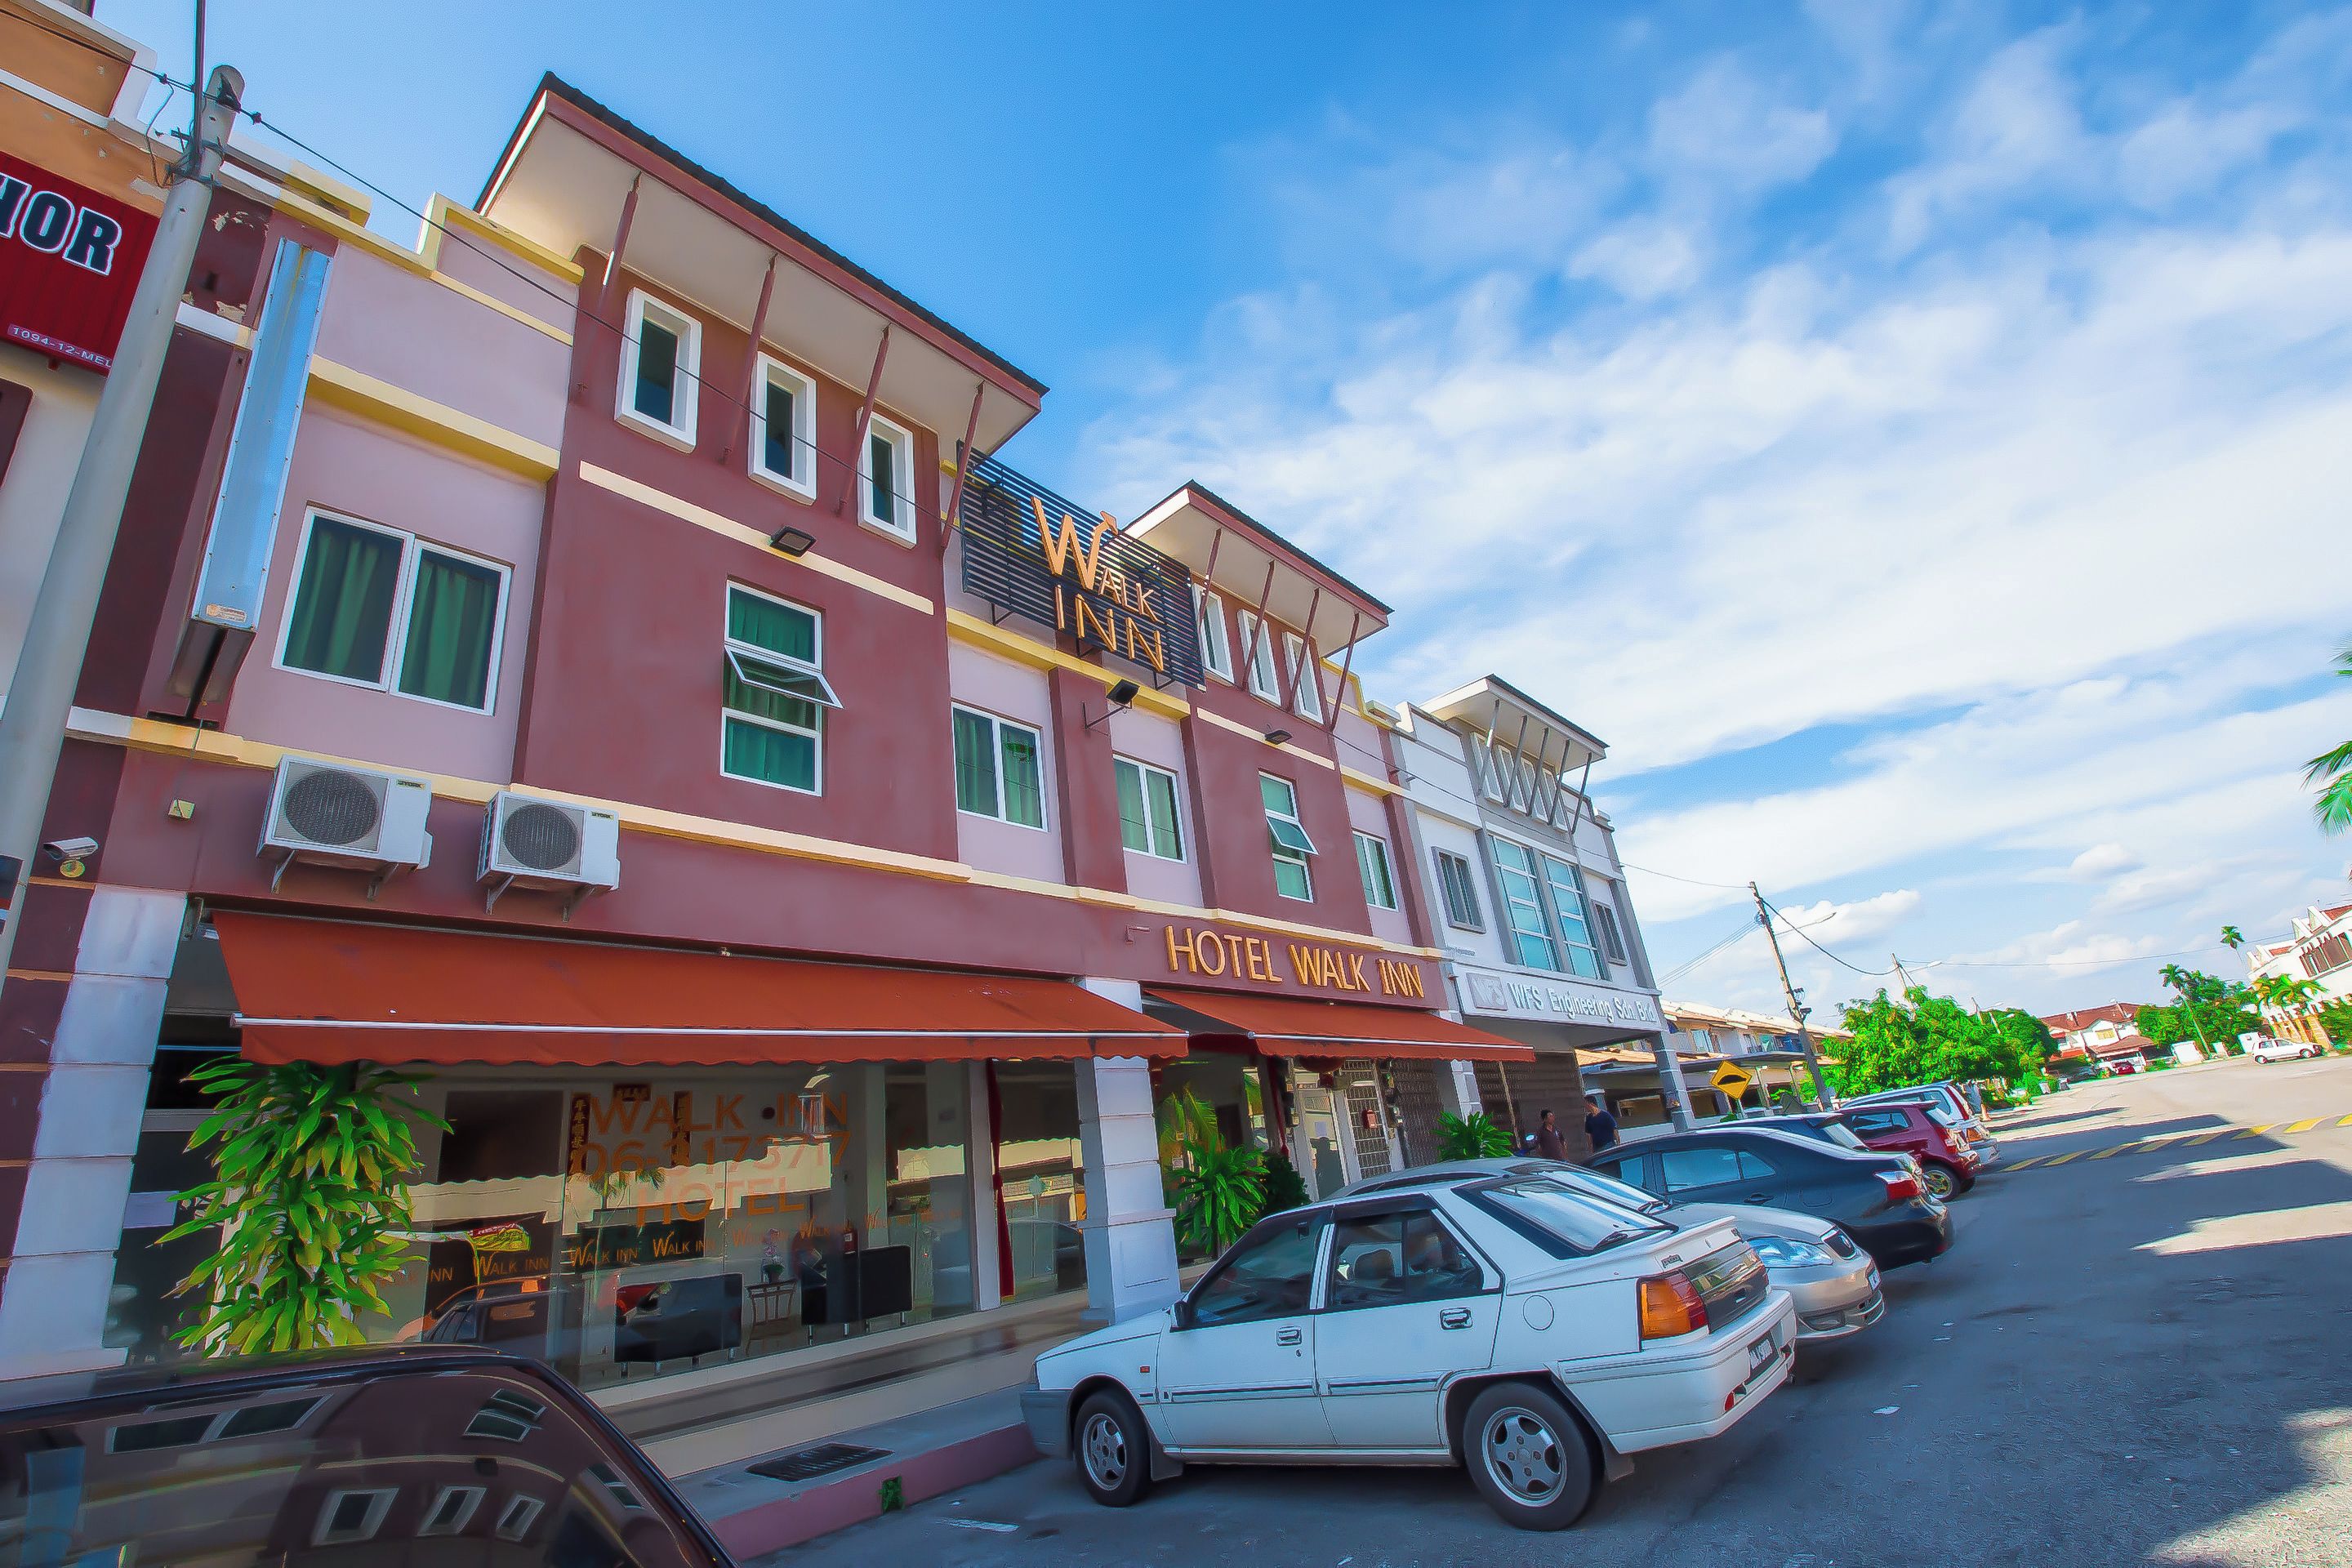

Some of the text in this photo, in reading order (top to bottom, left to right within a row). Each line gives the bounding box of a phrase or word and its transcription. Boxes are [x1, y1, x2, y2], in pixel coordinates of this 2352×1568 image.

[1031, 496, 1159, 622] WALK
[1054, 584, 1164, 672] INN
[1165, 924, 1426, 1000] HOTEL WALK INN
[1507, 982, 1544, 1011] WFS
[1547, 987, 1615, 1024] Engineering
[590, 1090, 746, 1135] WALK
[776, 1091, 848, 1129] INN
[637, 1175, 805, 1228] HOTEL
[428, 1267, 454, 1282] NN
[653, 1230, 691, 1258] WALK
